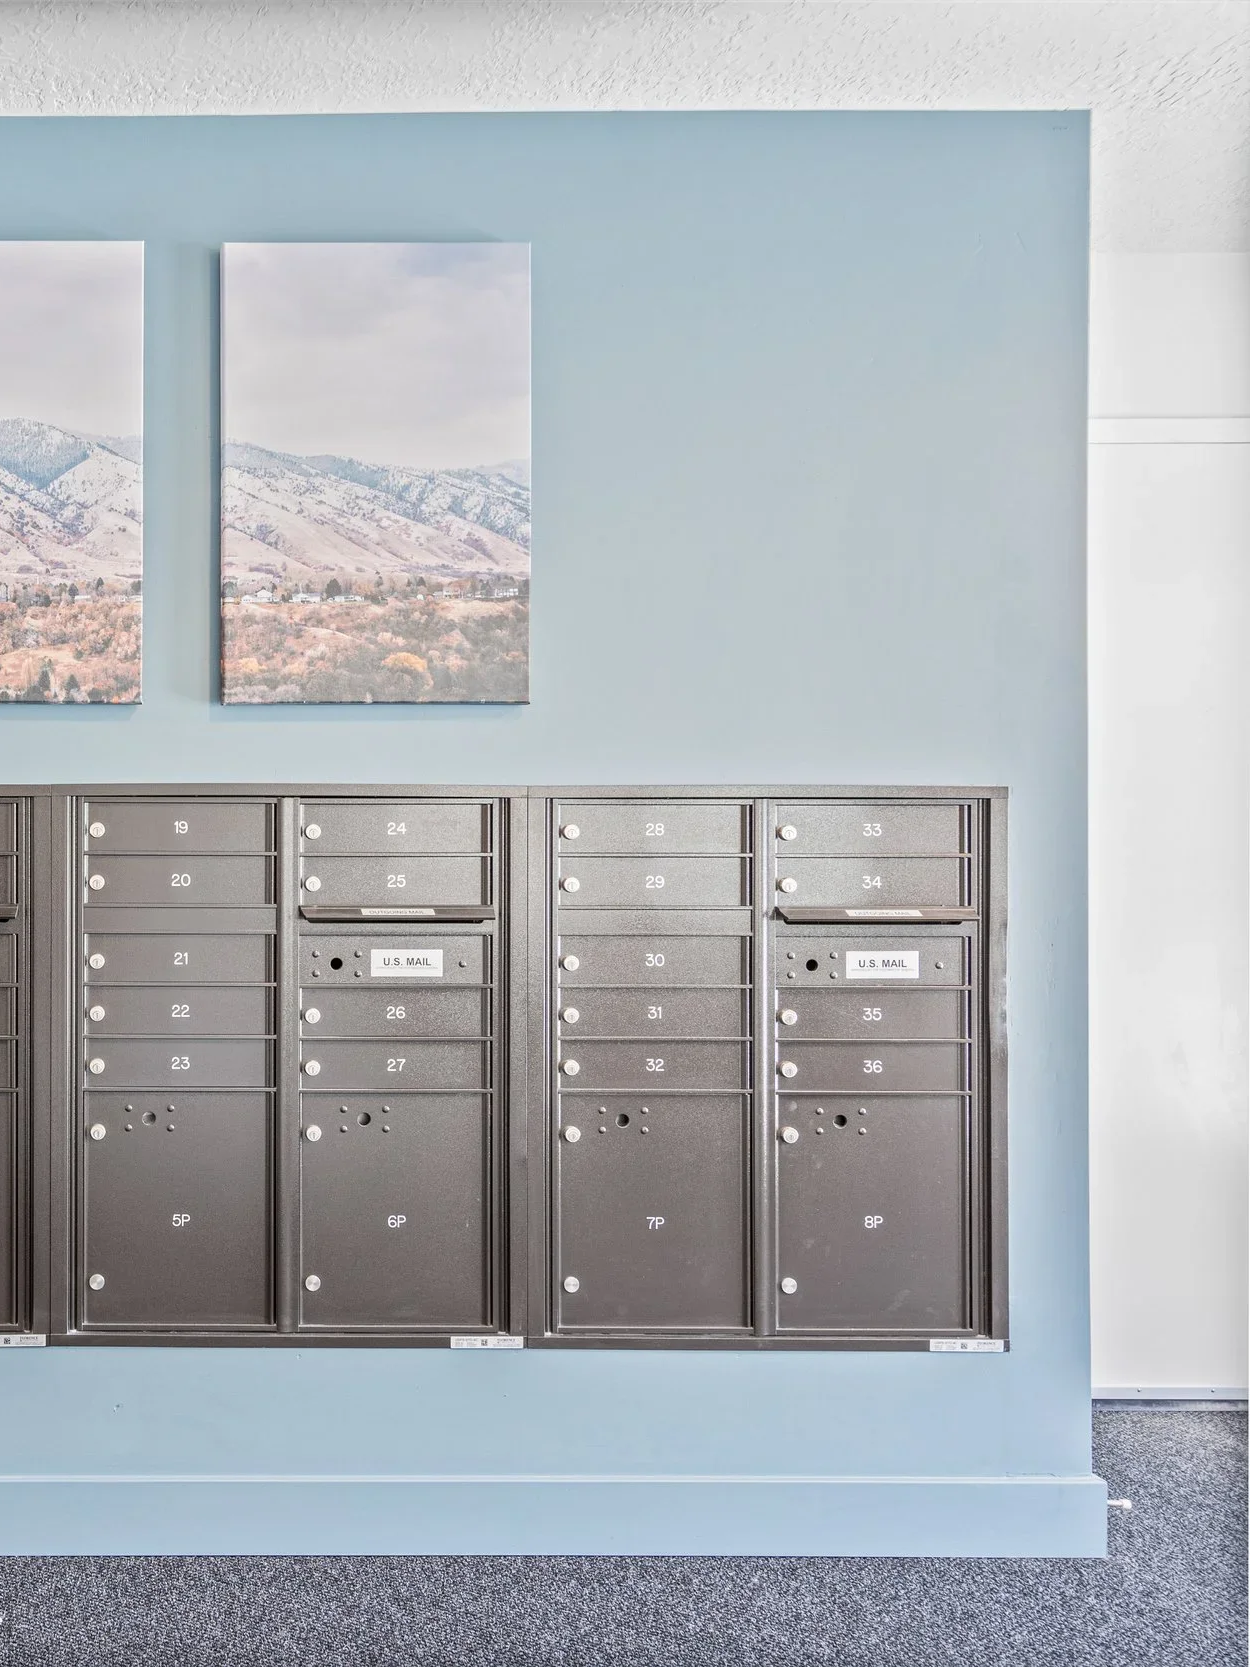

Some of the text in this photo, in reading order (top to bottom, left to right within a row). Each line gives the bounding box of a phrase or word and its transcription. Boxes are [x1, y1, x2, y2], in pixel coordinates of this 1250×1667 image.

[174, 820, 189, 834] 19
[387, 821, 407, 836] 24
[645, 822, 665, 836] 28
[862, 823, 882, 837] 33
[171, 873, 191, 887] 20
[387, 874, 407, 888] 25
[645, 875, 665, 889] 29
[862, 875, 882, 889] 34
[173, 951, 189, 965] 21
[382, 957, 432, 967] U.S. MAIL
[645, 953, 665, 967] 30
[858, 959, 907, 968] U.S. MAIL
[171, 1004, 191, 1018] 22
[386, 1005, 406, 1019] 26
[647, 1006, 662, 1020] 31
[862, 1007, 882, 1021] 35
[171, 1056, 191, 1070] 23
[387, 1058, 406, 1072] 27
[645, 1058, 665, 1072] 32
[863, 1059, 883, 1074] 36
[172, 1213, 191, 1227] 5P
[387, 1214, 407, 1228] 6P
[646, 1216, 665, 1230] 7P
[864, 1215, 884, 1229] 8P
